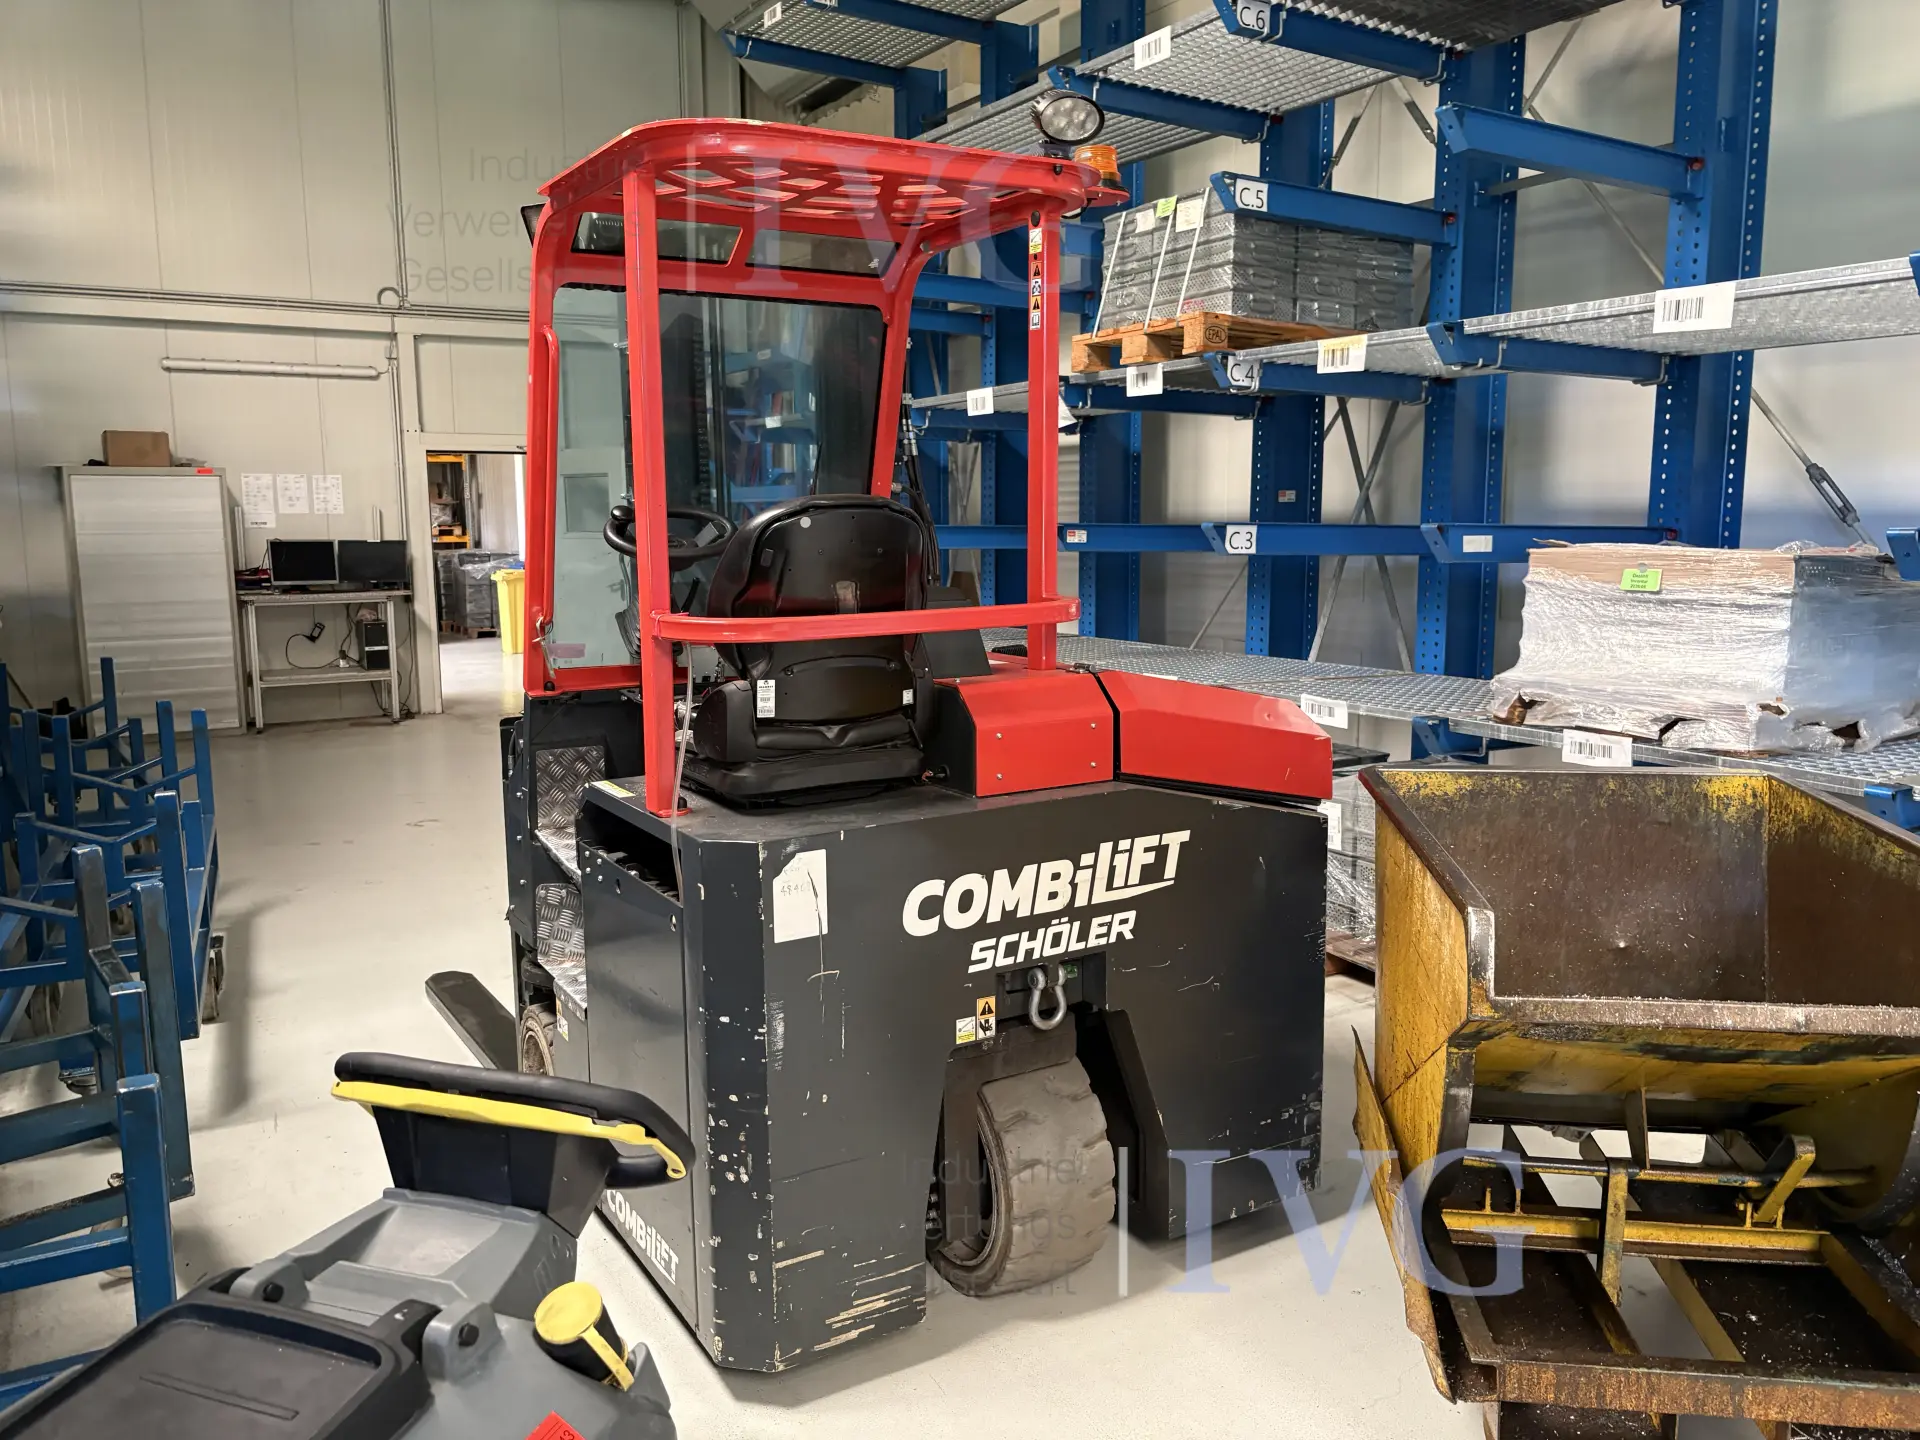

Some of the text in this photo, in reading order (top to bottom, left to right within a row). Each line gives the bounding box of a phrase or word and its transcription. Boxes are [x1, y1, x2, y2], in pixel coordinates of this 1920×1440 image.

[1239, 5, 1266, 31] C.6
[1239, 187, 1264, 209] C.5
[1229, 361, 1255, 384] C.4
[1228, 530, 1253, 550] C.3
[967, 910, 1137, 974] SCHÖLER
